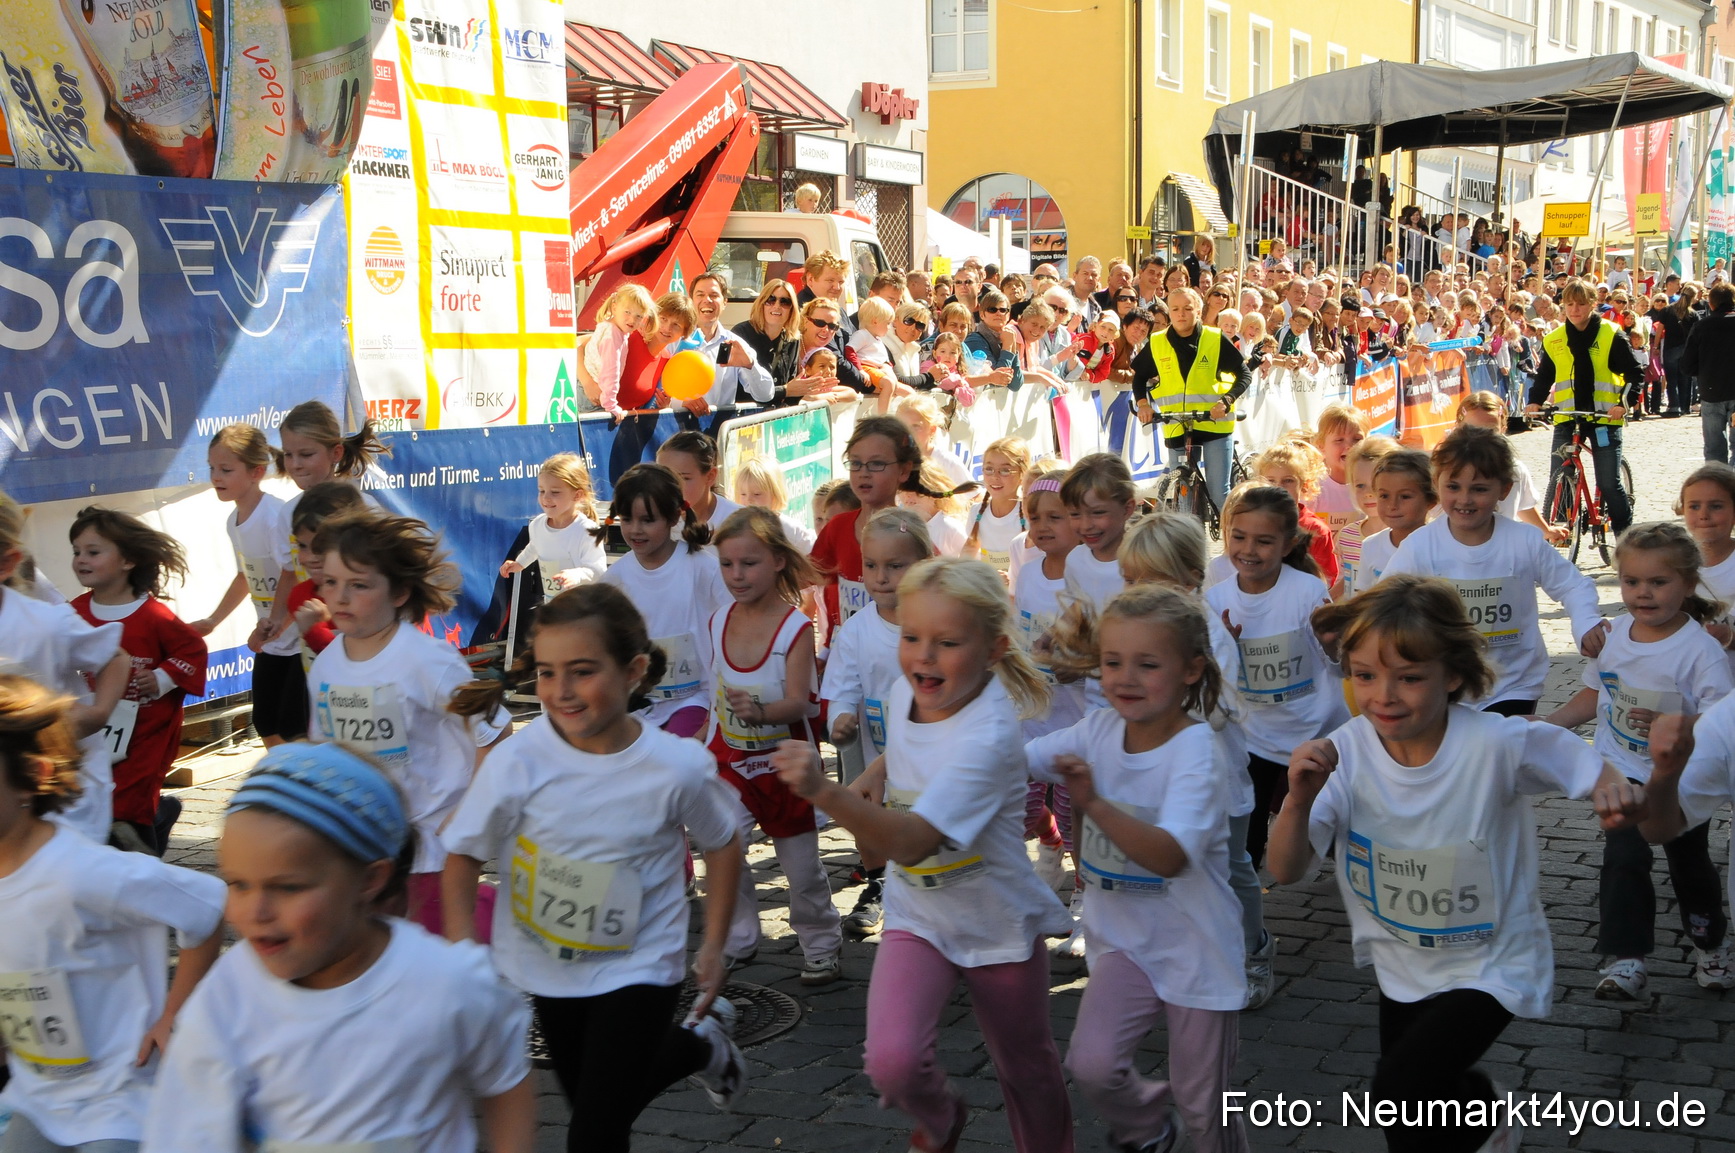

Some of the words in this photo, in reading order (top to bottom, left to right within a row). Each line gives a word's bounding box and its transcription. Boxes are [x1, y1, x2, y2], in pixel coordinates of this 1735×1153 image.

[504, 27, 554, 59] MCM
[376, 65, 391, 78] SIE!
[242, 45, 286, 136] Leben
[51, 62, 96, 153] Bier
[863, 81, 920, 126] Döpfer
[696, 105, 721, 139] 6352
[358, 144, 408, 161] INTERSPORT
[514, 153, 558, 167] GERHART
[799, 146, 830, 161] GARDINEN
[352, 159, 410, 180] HACKNER
[452, 162, 477, 176] MAX
[480, 162, 505, 178] BÖGL
[867, 156, 879, 167] BABY
[885, 160, 920, 174] KINDERMODEN
[1546, 211, 1588, 221] Schnupper-
[1636, 204, 1661, 214] Jugend-
[1642, 212, 1655, 220] lauf
[1558, 221, 1574, 229] lauf
[364, 257, 406, 269] WITTMANN
[1031, 253, 1053, 261] Digitale
[441, 249, 506, 283] Sinupret
[441, 285, 481, 311] forte
[364, 398, 422, 420] MERZ
[410, 467, 436, 487] und
[439, 465, 480, 486] Türme
[499, 460, 524, 481] sind
[1329, 515, 1348, 525] Lucy
[989, 554, 1011, 564] Hanna
[1468, 603, 1513, 626] 059
[1488, 633, 1519, 643] FLEIDERER
[1243, 642, 1280, 657] Leonie
[1248, 655, 1304, 682] 7057
[335, 717, 396, 742] 7229
[746, 760, 770, 774] DEHN
[1377, 851, 1428, 882] Emily
[1382, 882, 1481, 917] 7065
[538, 889, 627, 937] 7215
[1435, 928, 1495, 945] PFLEIDERER
